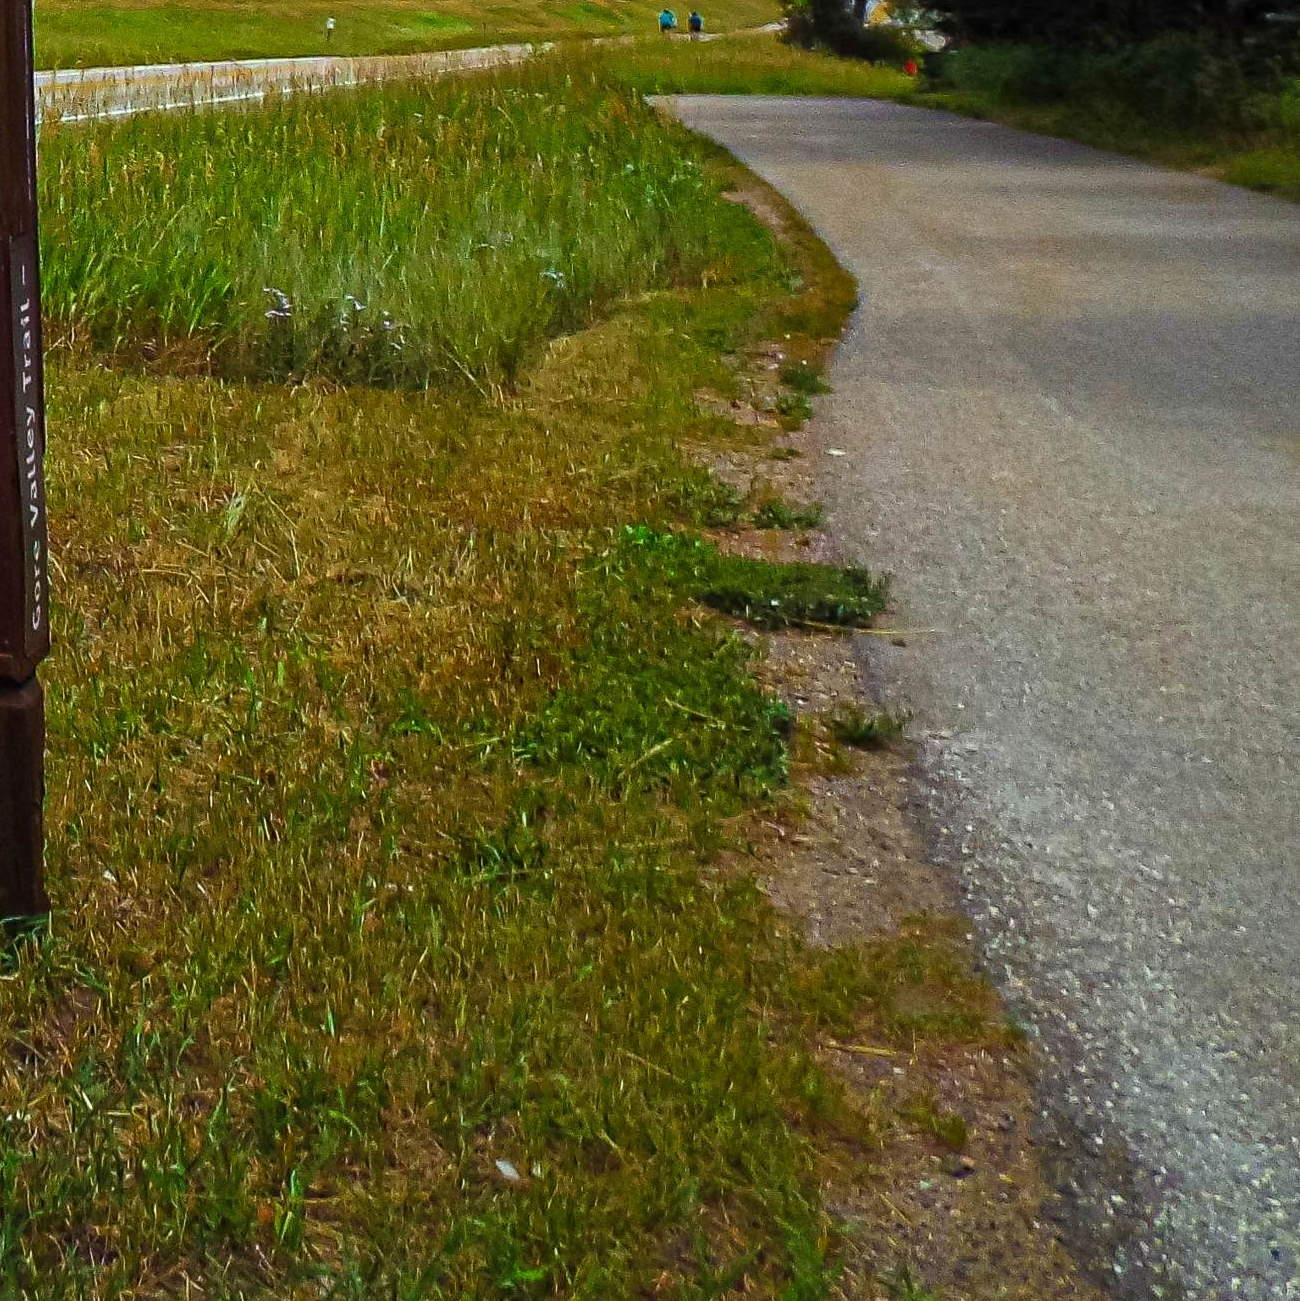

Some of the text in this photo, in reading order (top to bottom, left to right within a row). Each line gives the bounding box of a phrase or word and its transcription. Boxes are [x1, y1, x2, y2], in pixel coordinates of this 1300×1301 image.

[19, 298, 42, 631] Gore Valley Trail
